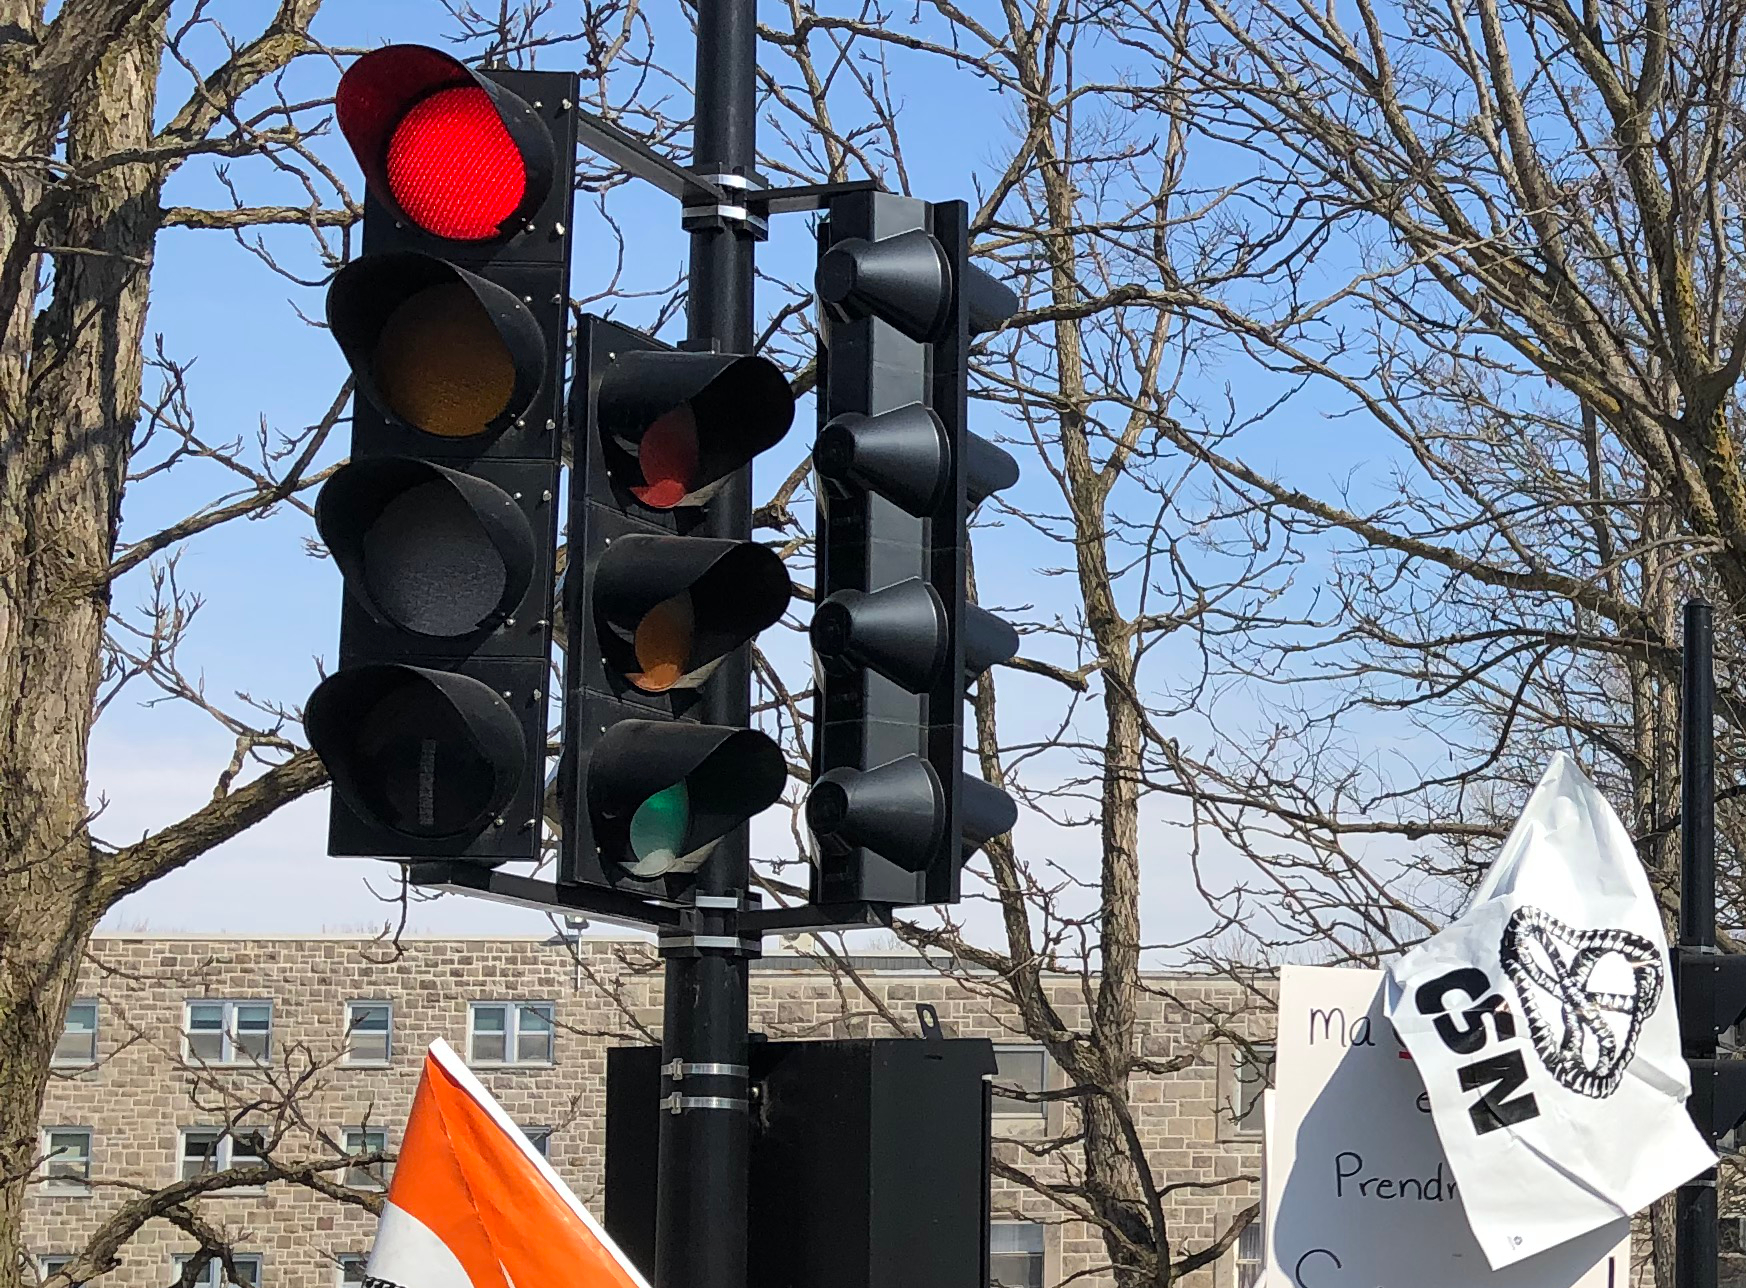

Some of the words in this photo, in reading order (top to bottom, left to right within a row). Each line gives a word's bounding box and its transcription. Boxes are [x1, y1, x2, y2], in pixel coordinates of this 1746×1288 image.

[1309, 1007, 1376, 1048] ma
[1414, 967, 1540, 1136] CSN
[1335, 1151, 1459, 1202] Prendr
